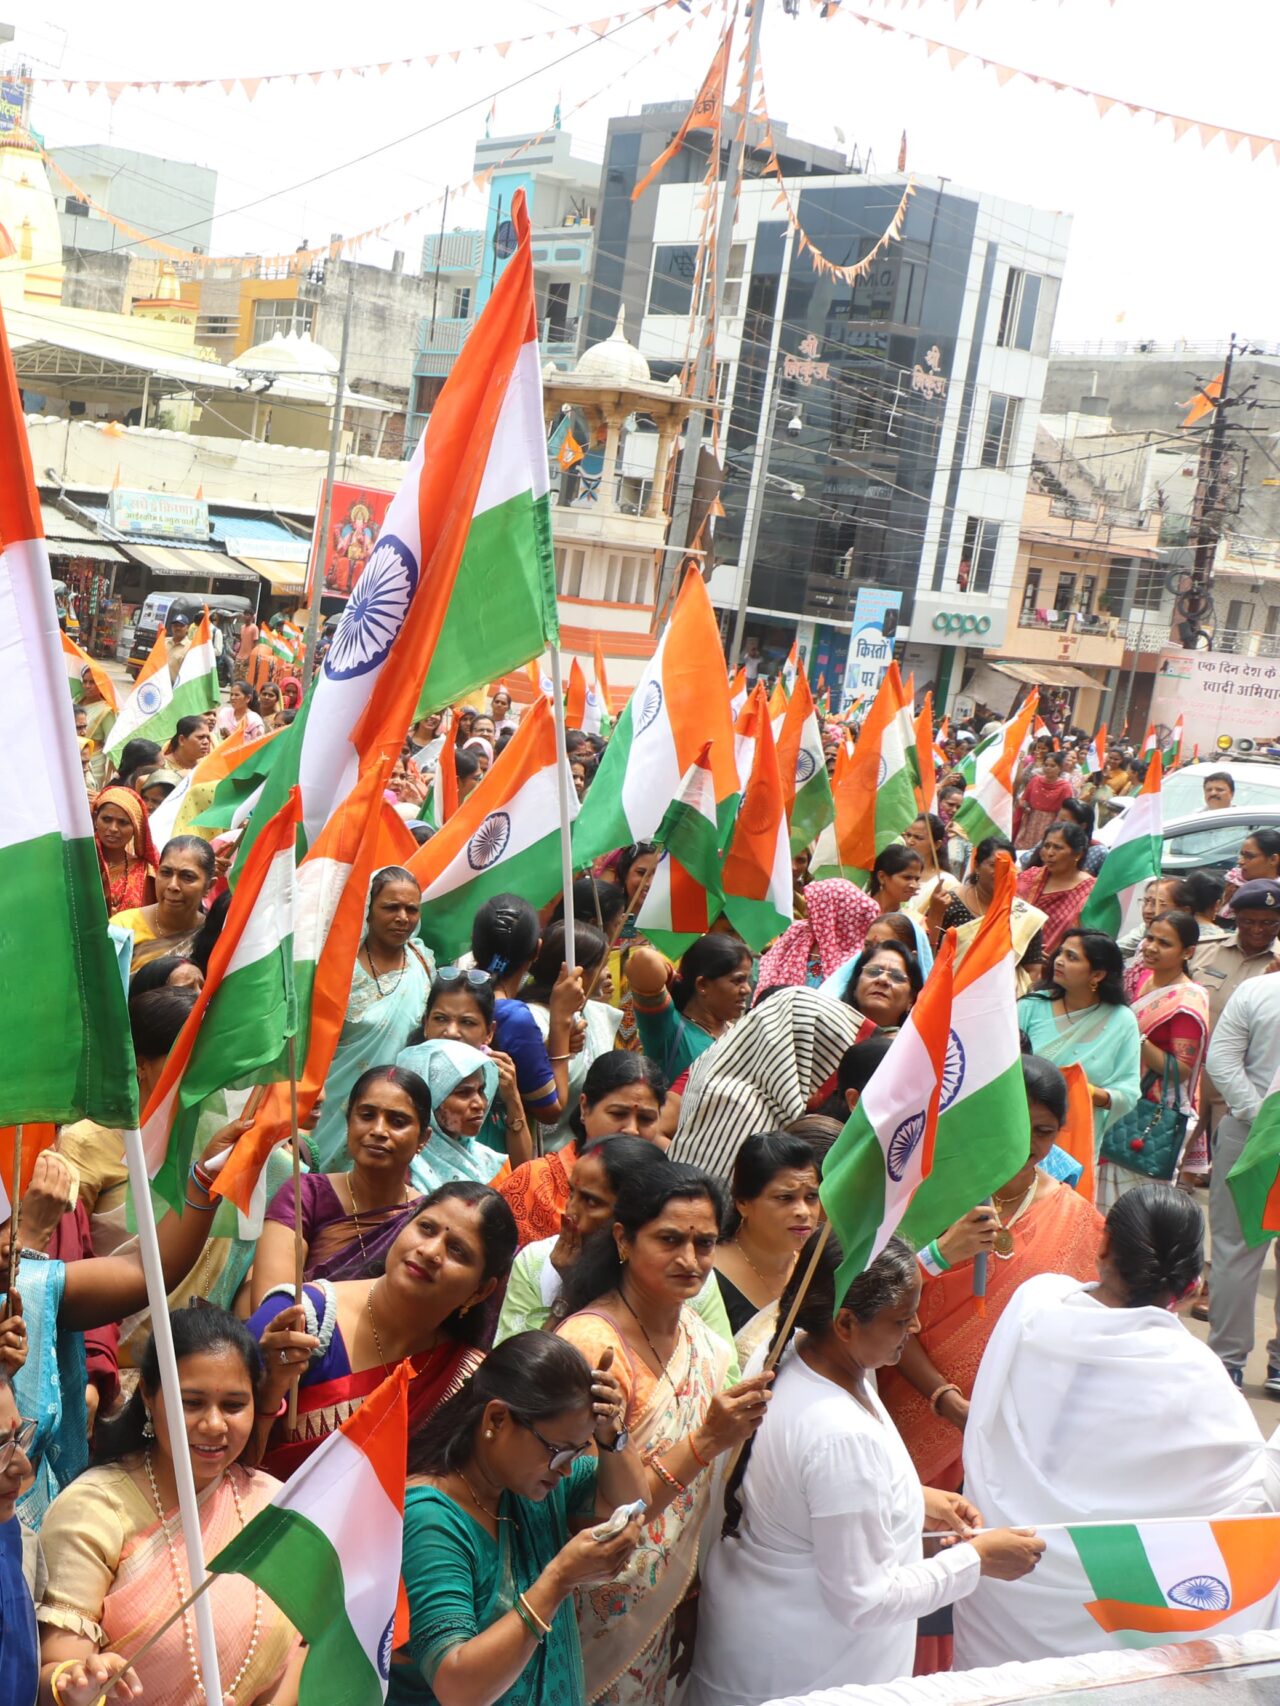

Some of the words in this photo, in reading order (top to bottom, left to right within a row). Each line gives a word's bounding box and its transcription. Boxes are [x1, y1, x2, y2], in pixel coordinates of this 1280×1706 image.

[932, 612, 992, 638] oppo
[861, 671, 875, 687] पर
[1198, 660, 1216, 672] एक
[1219, 660, 1240, 675] दिन
[1242, 662, 1261, 677] देश
[1264, 665, 1277, 679] के
